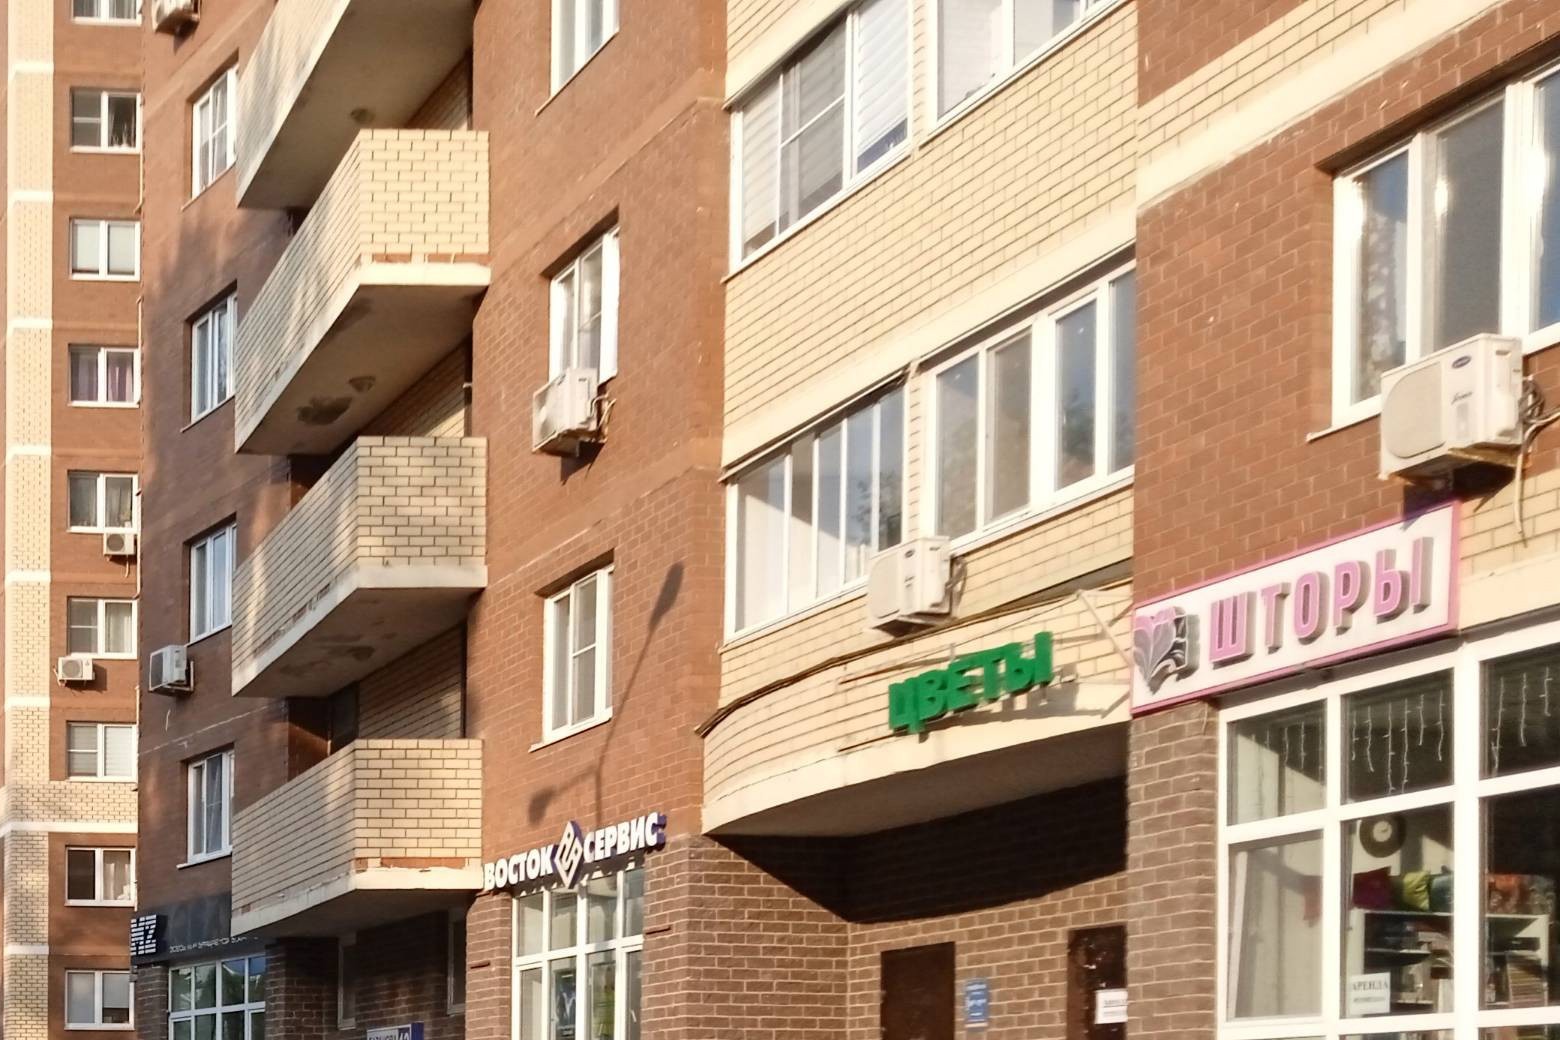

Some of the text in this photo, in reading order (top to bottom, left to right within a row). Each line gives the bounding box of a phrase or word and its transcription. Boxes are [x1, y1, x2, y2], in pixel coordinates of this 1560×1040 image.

[1209, 536, 1434, 671] ШТОРЫ
[888, 631, 1054, 734] ЦВЕТЫ
[483, 812, 662, 891] ВОСТОК СЕРВИС
